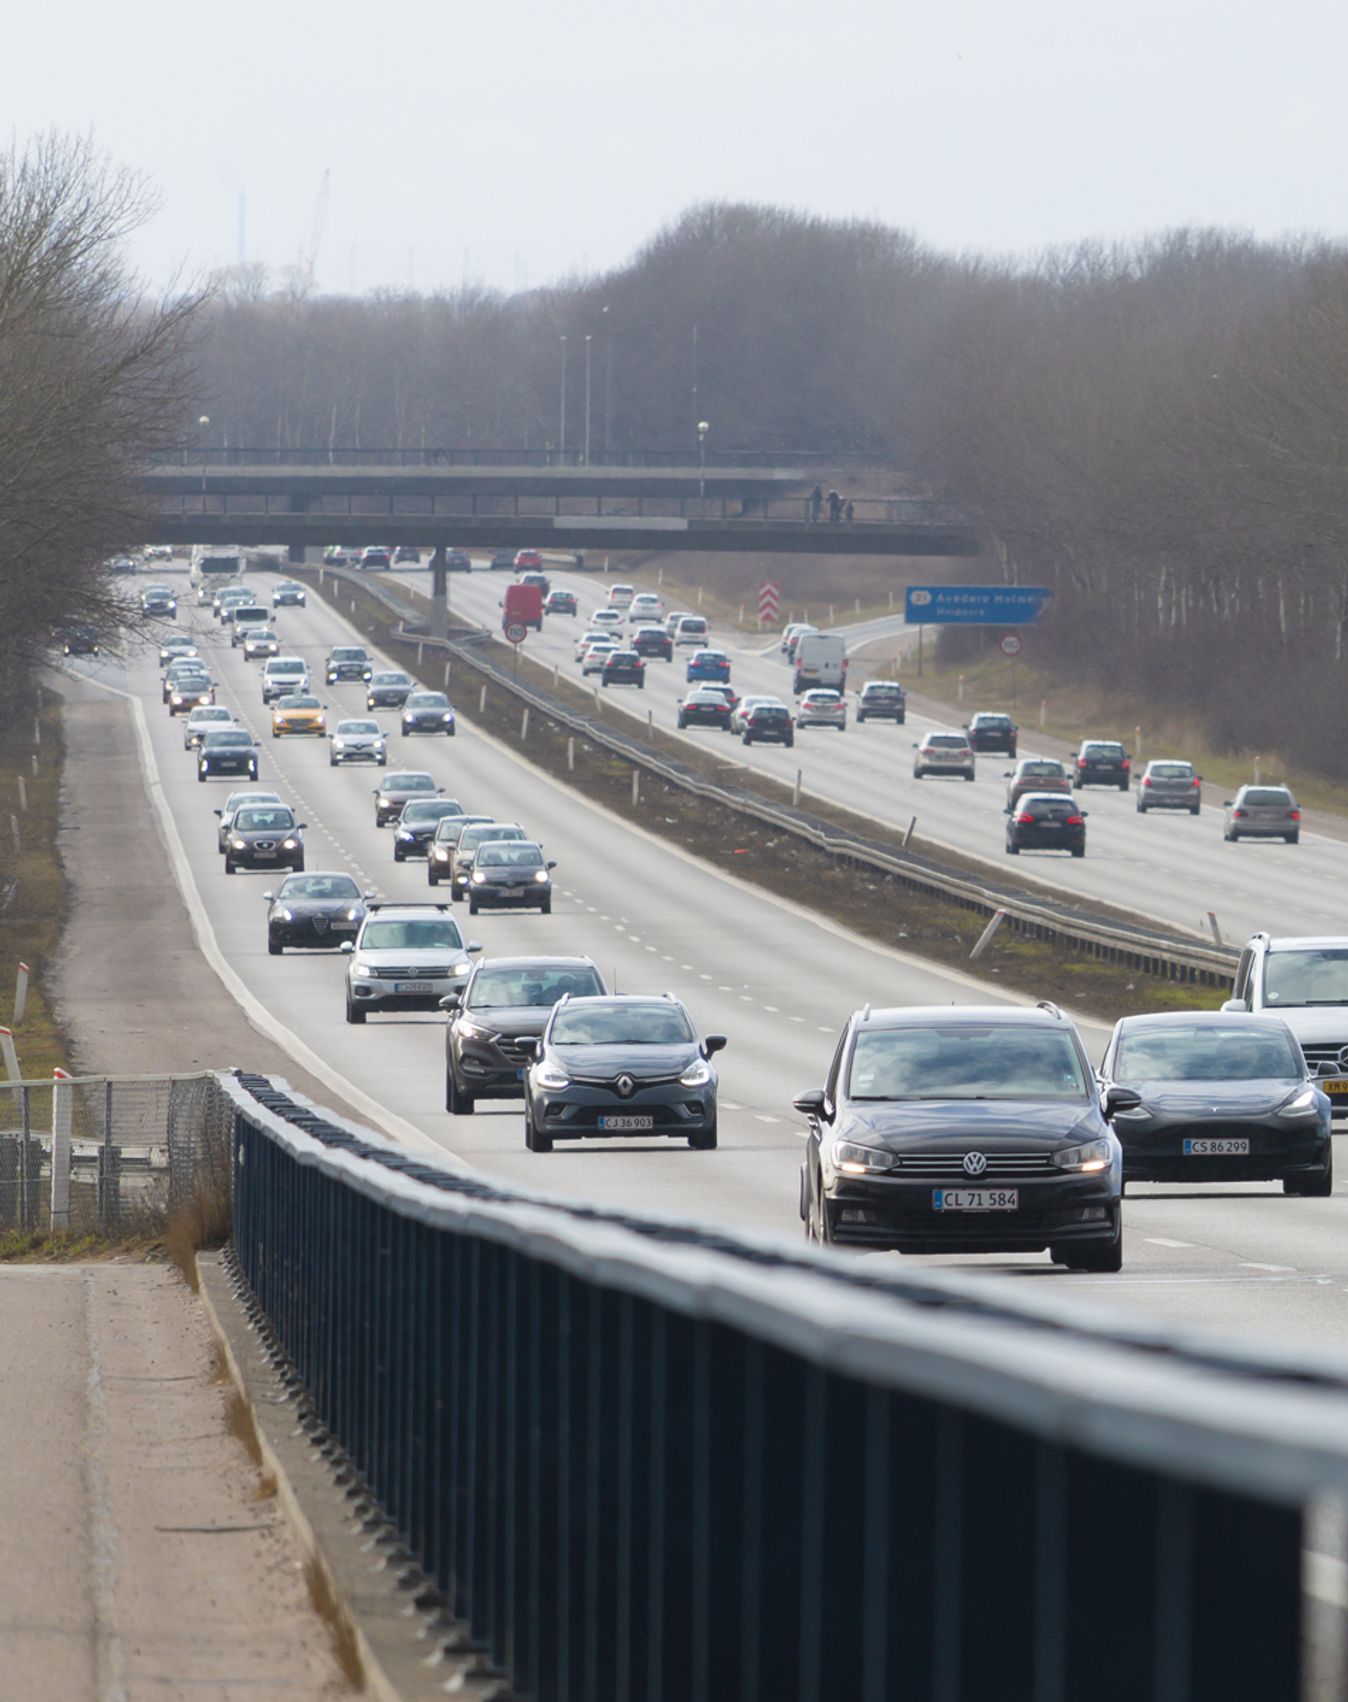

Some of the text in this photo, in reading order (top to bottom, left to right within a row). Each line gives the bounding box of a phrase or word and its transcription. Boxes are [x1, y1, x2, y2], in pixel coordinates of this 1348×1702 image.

[620, 1118, 632, 1128] 36
[634, 1118, 651, 1128] 903
[1192, 1141, 1247, 1153] CS 86 299
[944, 1192, 1016, 1207] CL 71 584
